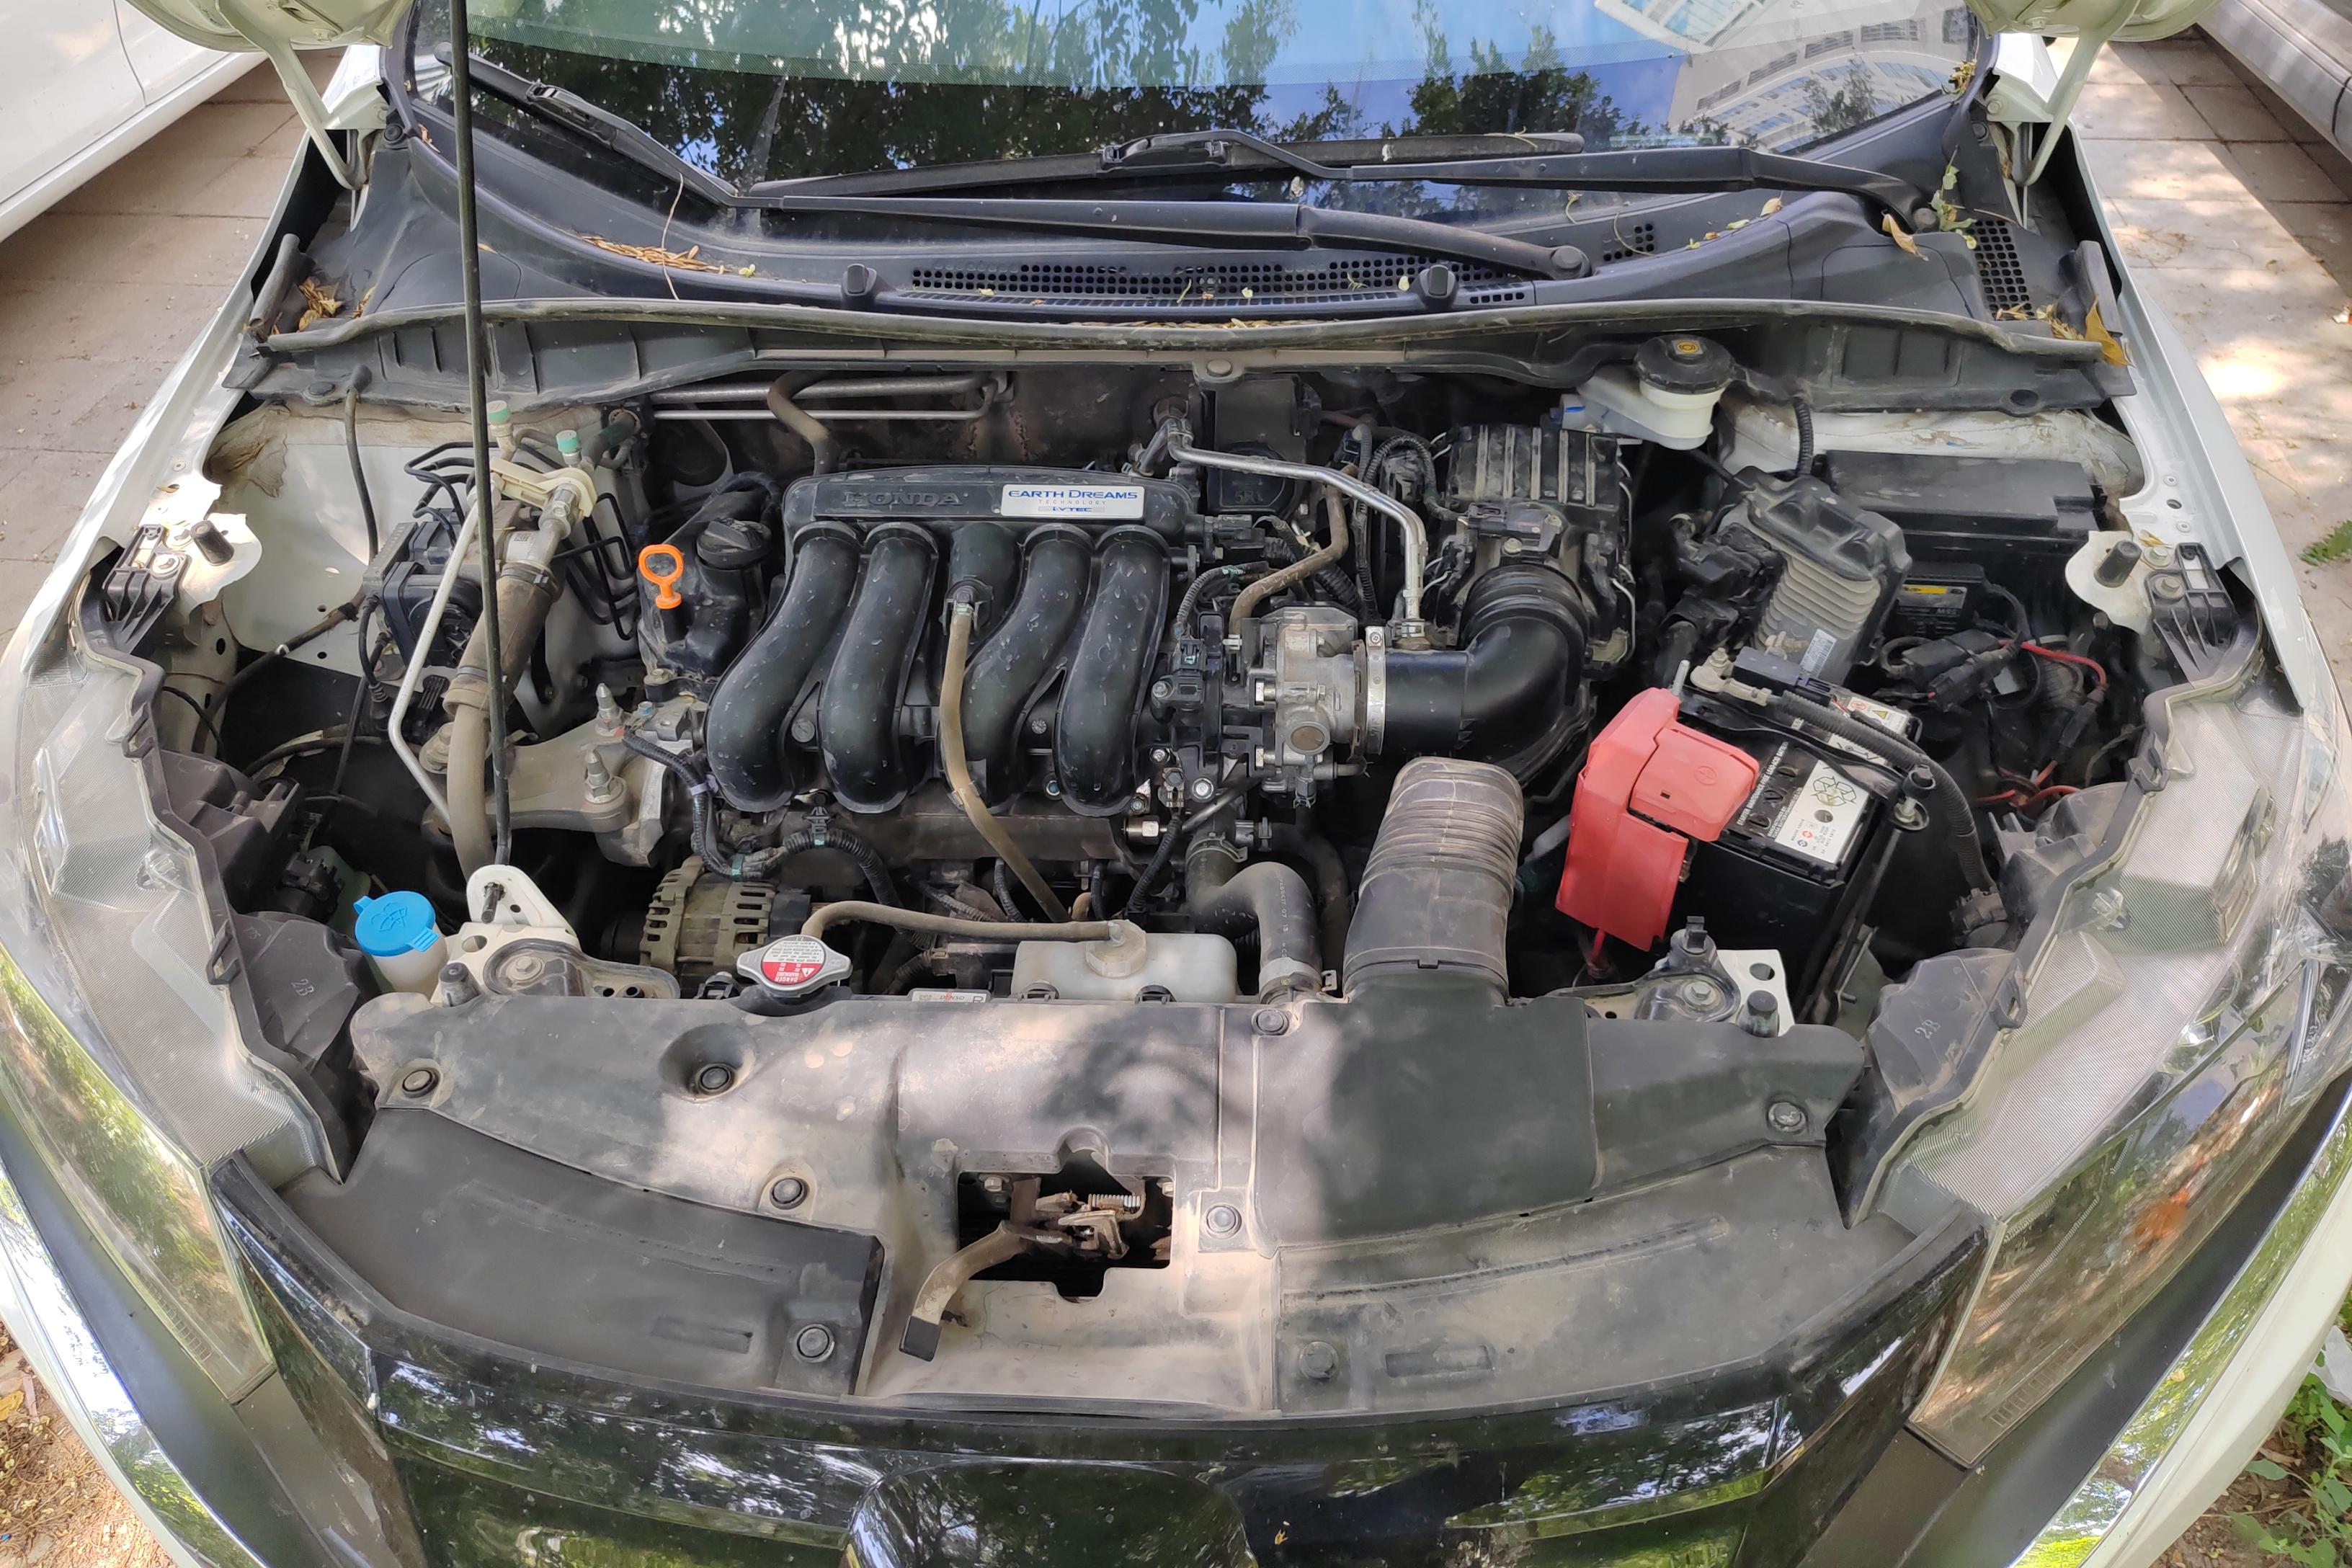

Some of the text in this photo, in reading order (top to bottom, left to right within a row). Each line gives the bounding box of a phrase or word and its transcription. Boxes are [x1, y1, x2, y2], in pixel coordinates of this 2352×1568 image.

[842, 491, 963, 507] HONDA
[1068, 489, 1139, 499] DREAMS
[1736, 808, 1751, 826] STARTER
